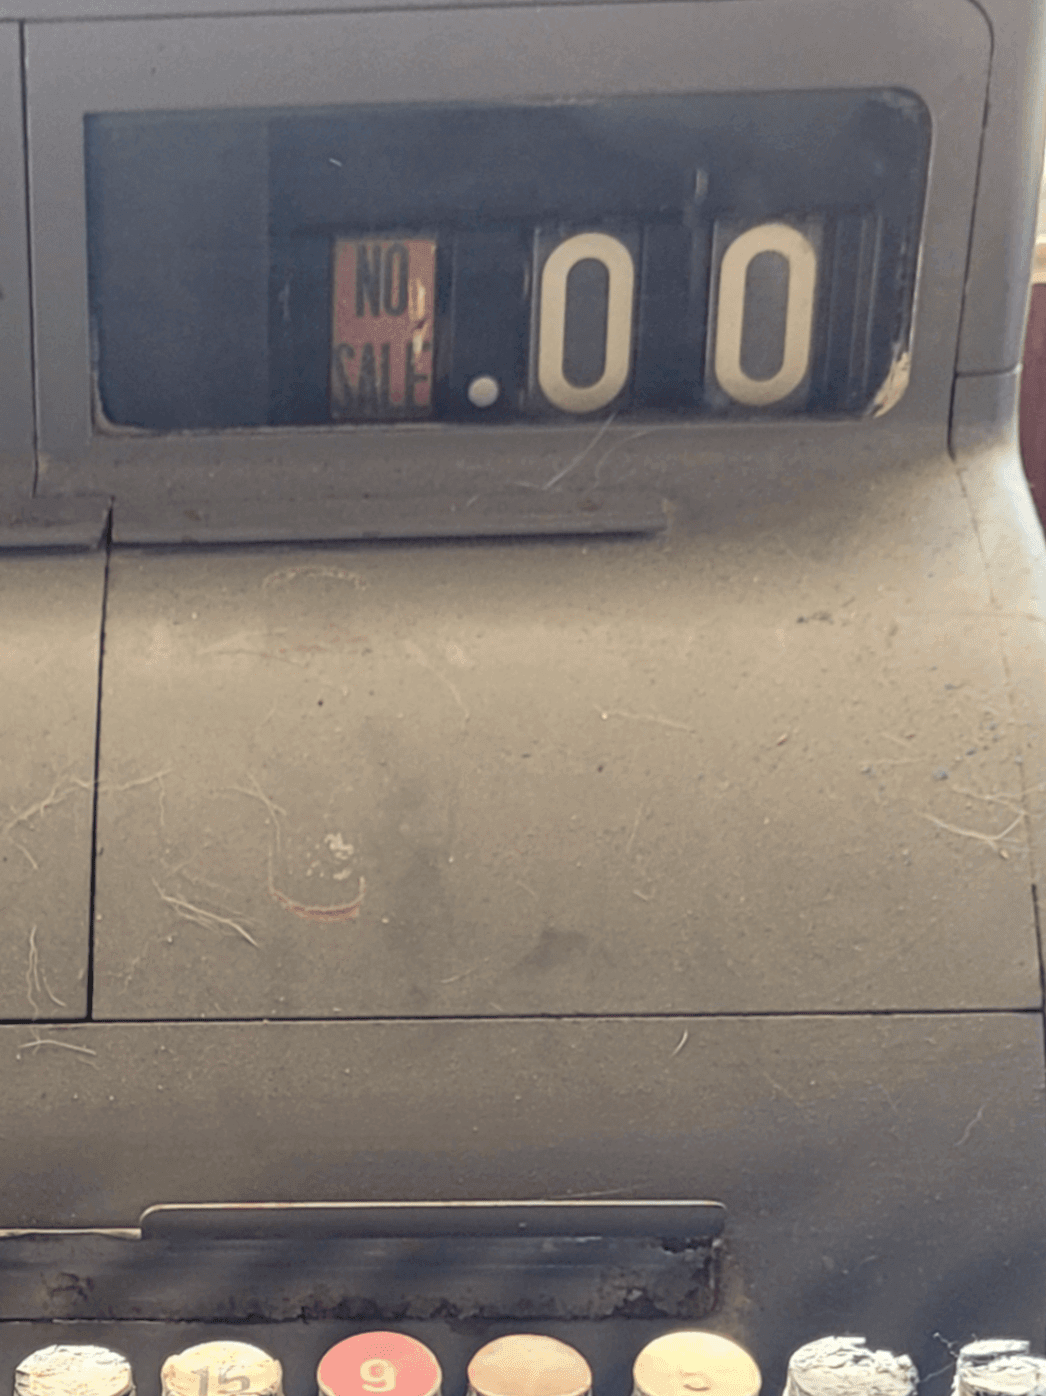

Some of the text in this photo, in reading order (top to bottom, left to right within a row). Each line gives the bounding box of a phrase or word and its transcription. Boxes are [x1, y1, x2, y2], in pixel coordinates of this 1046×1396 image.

[356, 241, 409, 318] NO
[332, 342, 433, 406] SALE
[359, 1358, 396, 1394] 9
